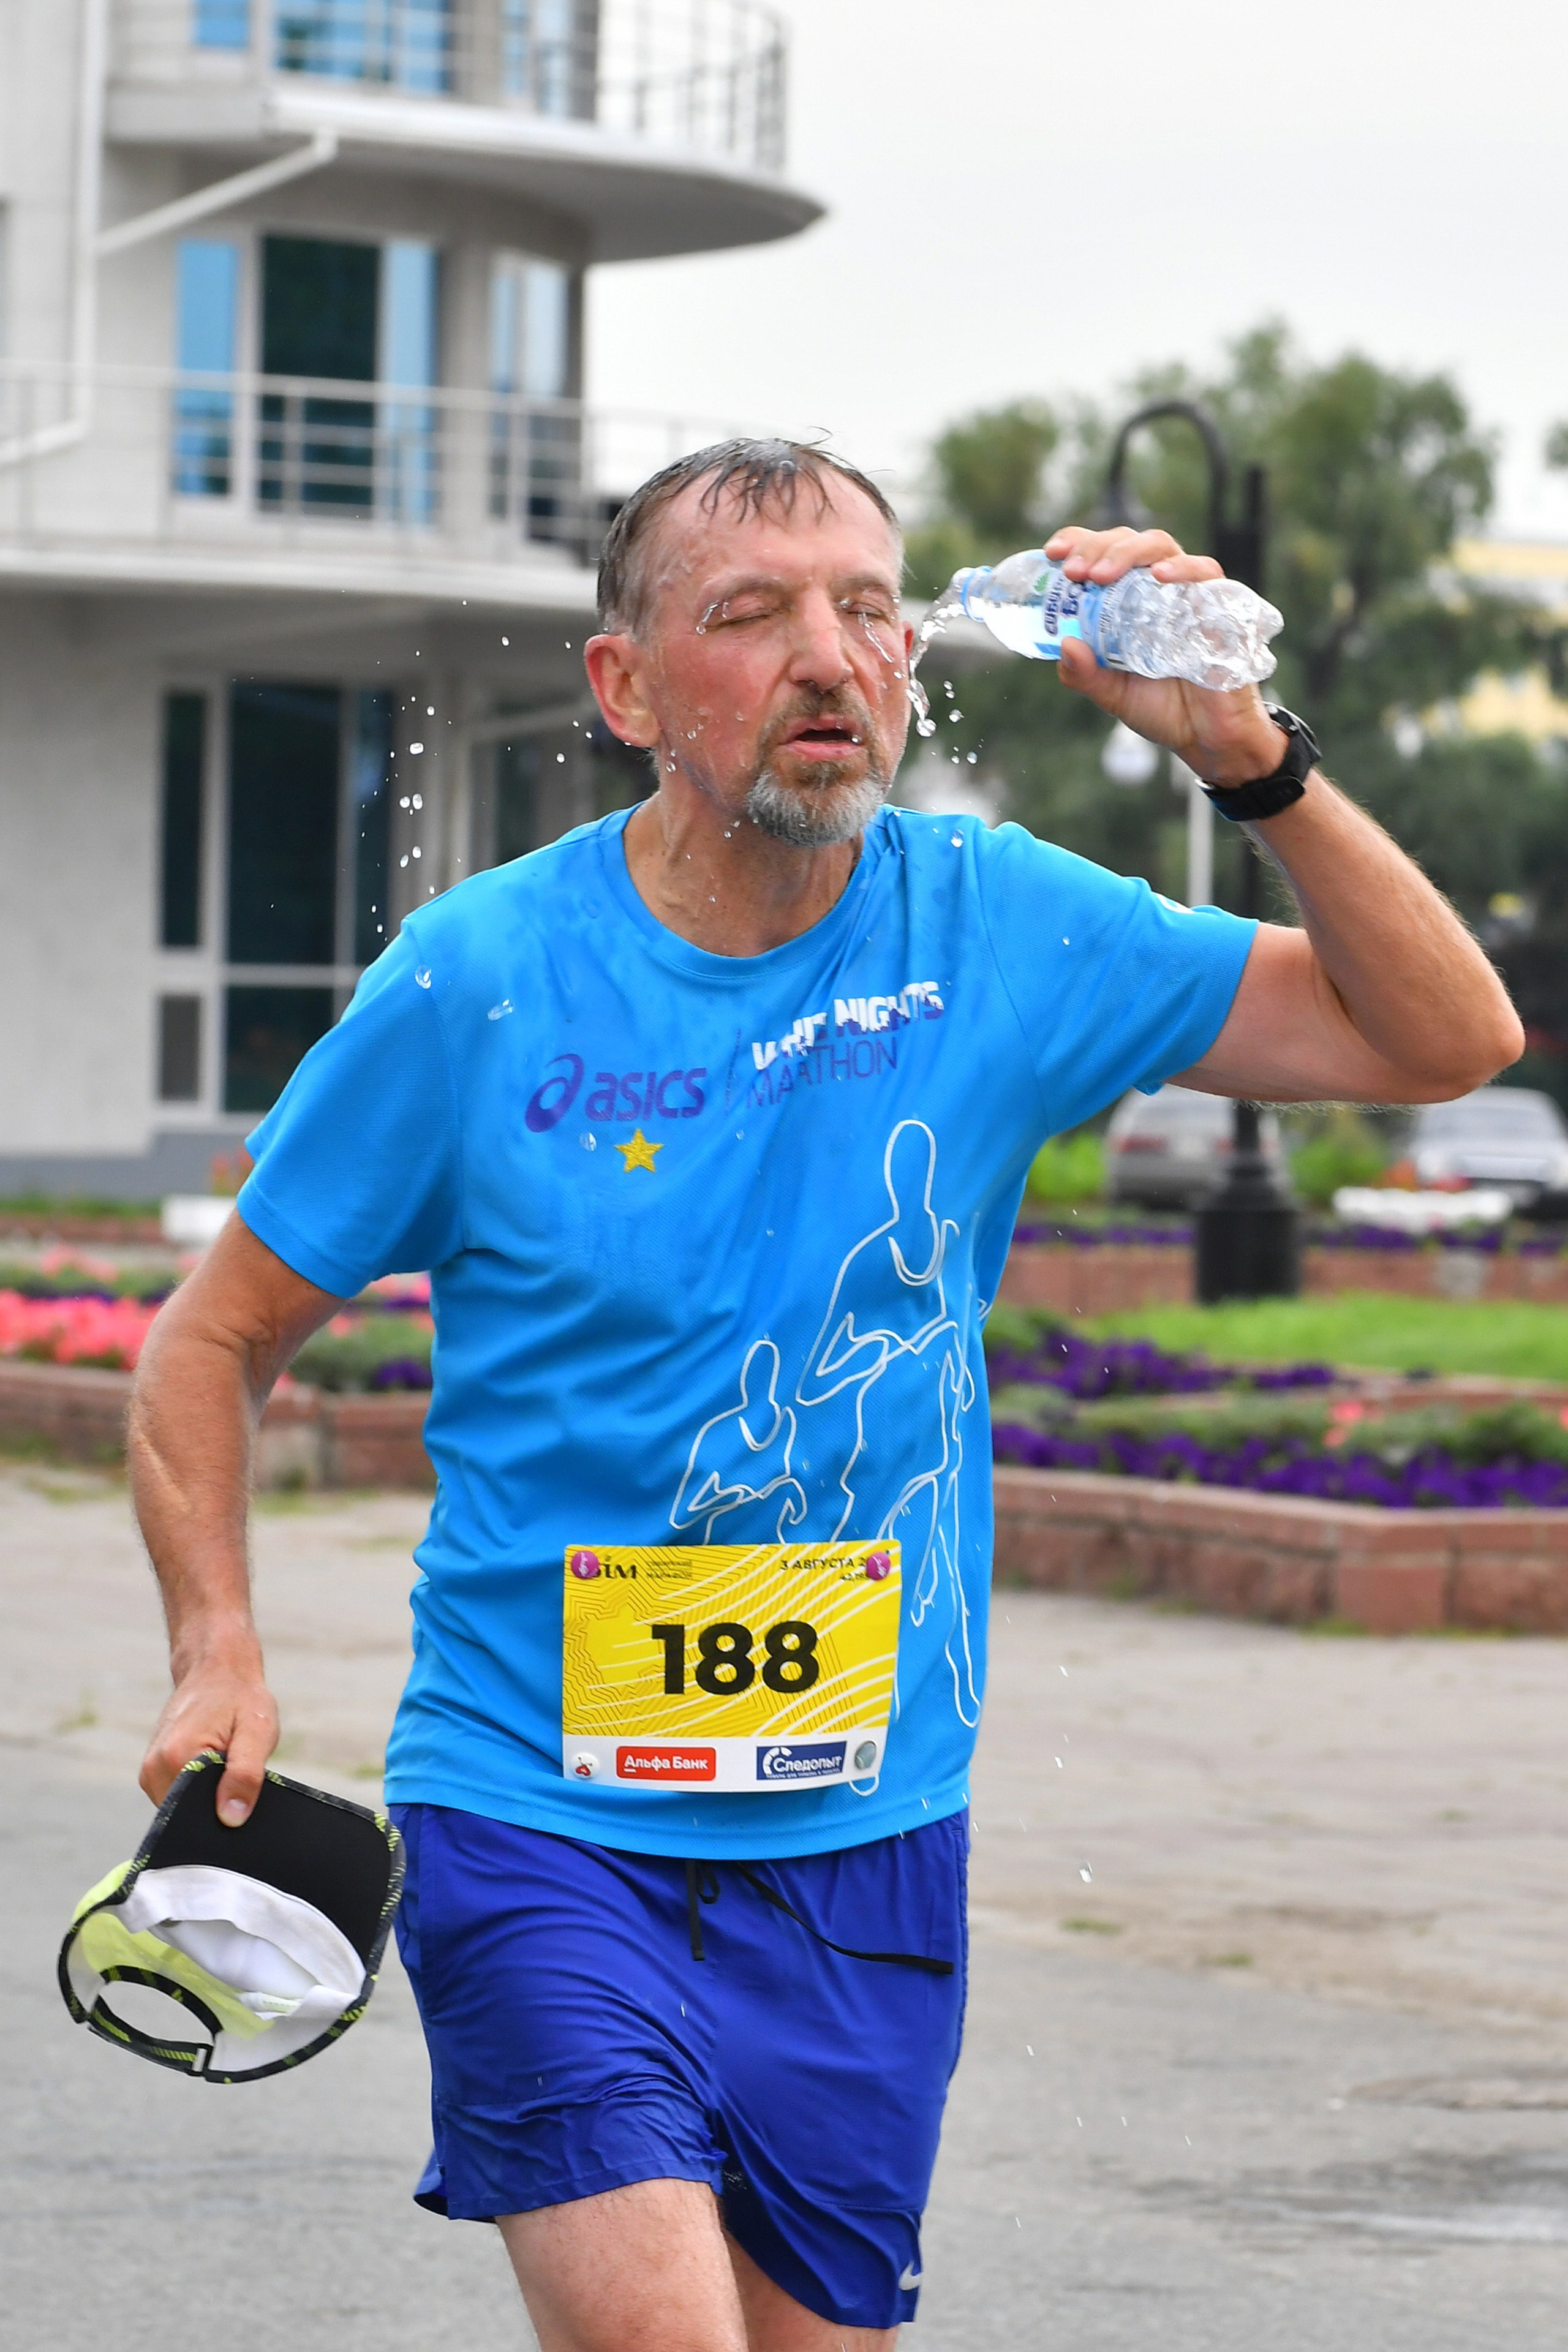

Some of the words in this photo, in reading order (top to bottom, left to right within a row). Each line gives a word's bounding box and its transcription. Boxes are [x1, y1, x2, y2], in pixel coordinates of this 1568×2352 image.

[834, 981, 944, 1038] NIGHTS
[584, 1067, 707, 1121] asics
[780, 1559, 789, 1571] 3
[792, 1558, 856, 1570] АВГУСТА
[652, 1620, 820, 1695] 188
[624, 1754, 671, 1773] Альфа
[672, 1755, 709, 1770] Банк
[772, 1755, 843, 1773] Следопыт
